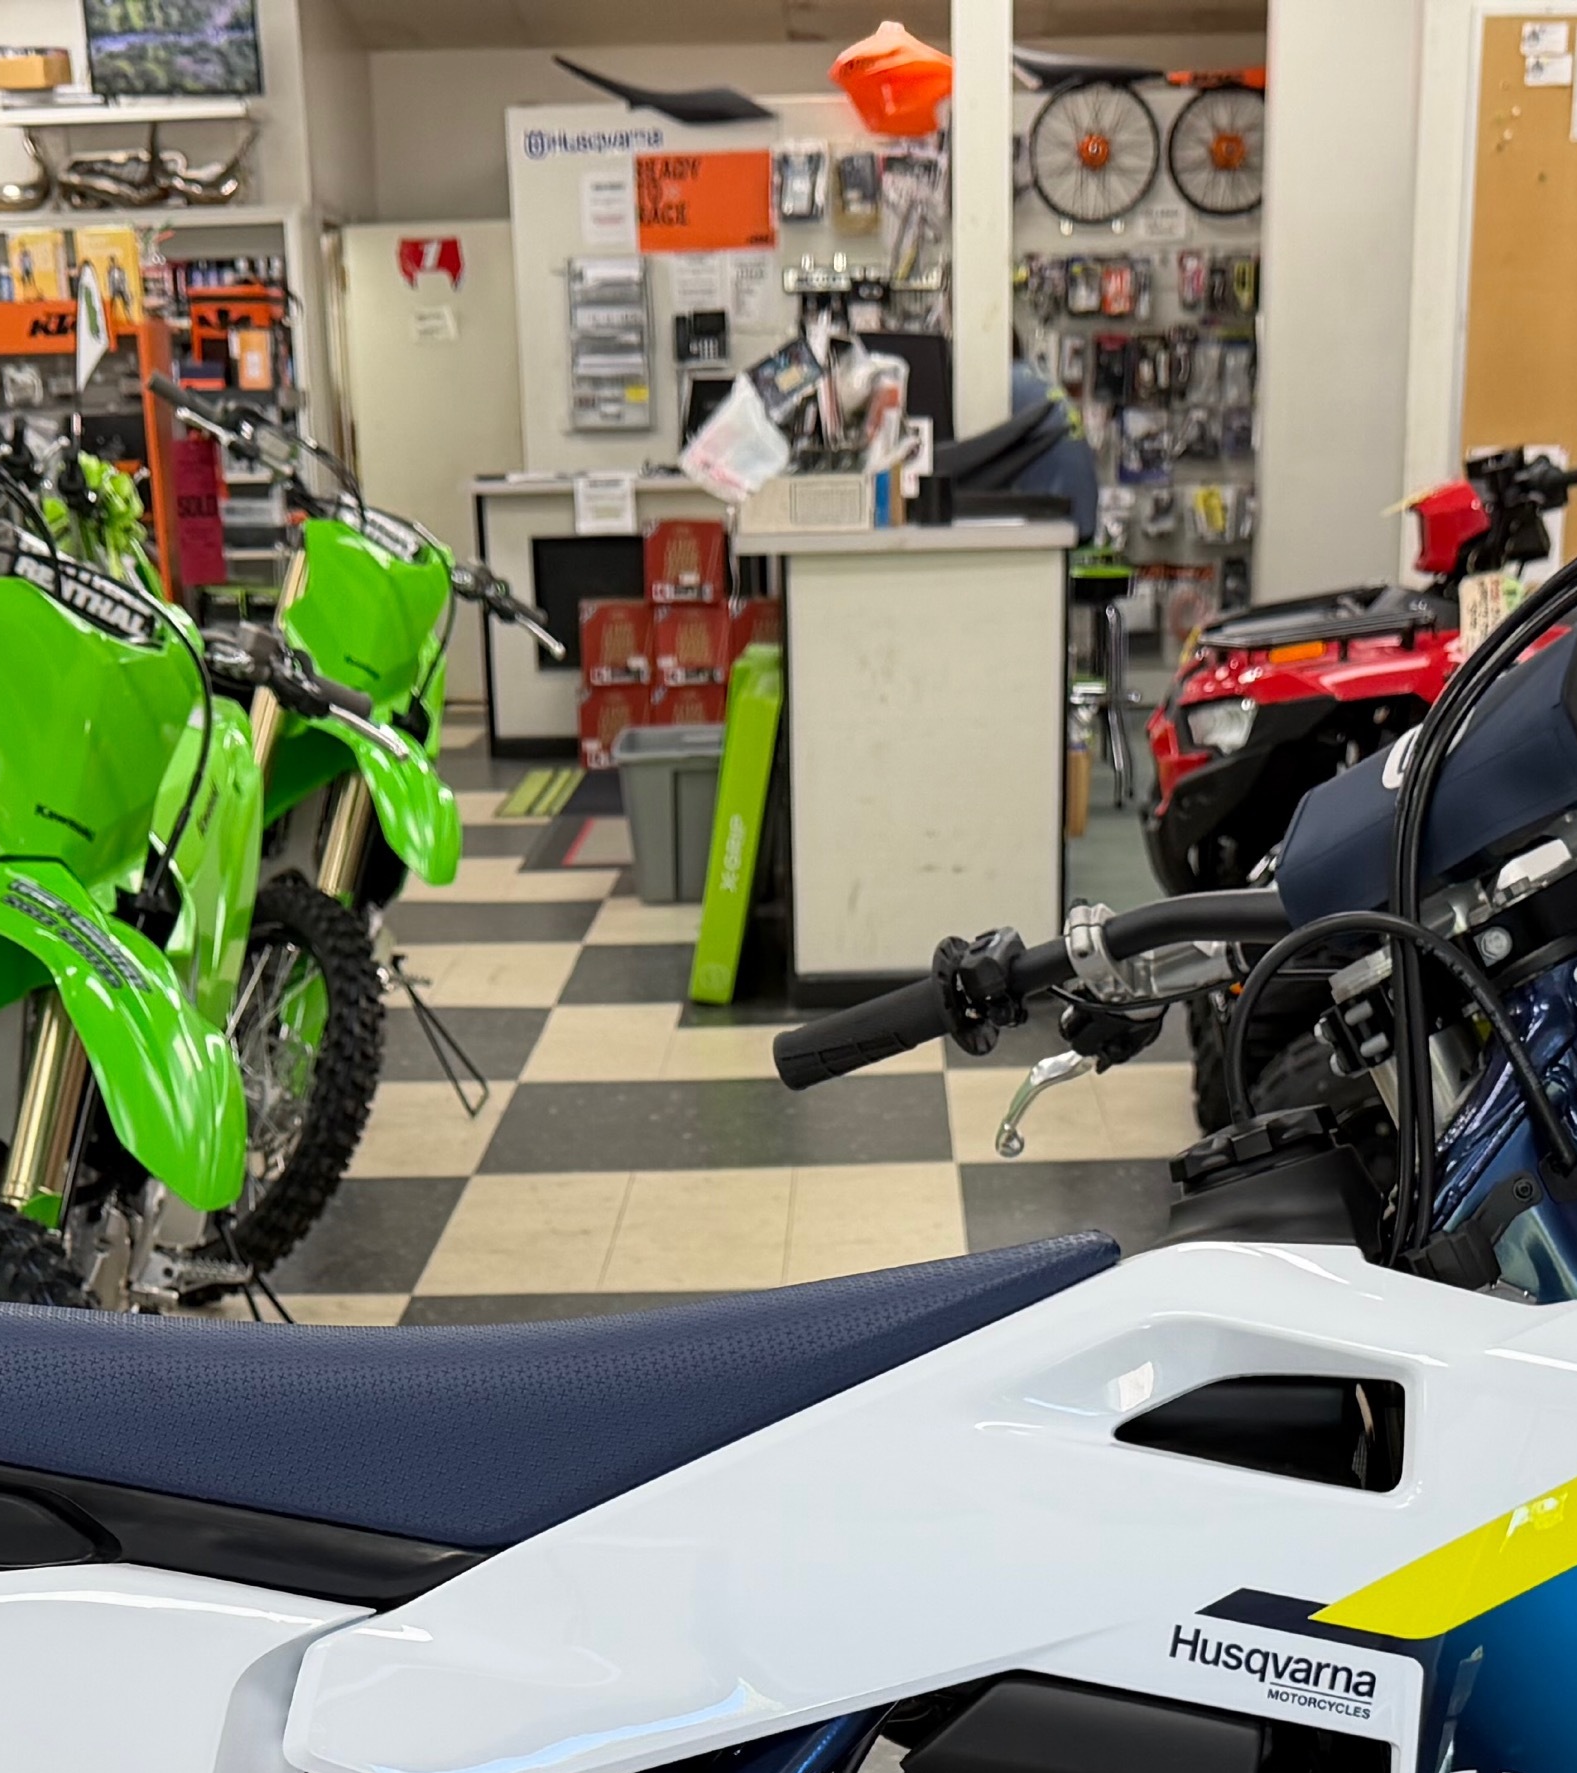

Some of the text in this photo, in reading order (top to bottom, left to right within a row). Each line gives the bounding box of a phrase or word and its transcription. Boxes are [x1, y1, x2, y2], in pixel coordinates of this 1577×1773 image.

[30, 316, 81, 338] KT
[1168, 1623, 1378, 1699] Husqvarna
[1266, 1687, 1372, 1721] MOTORCYCLES
